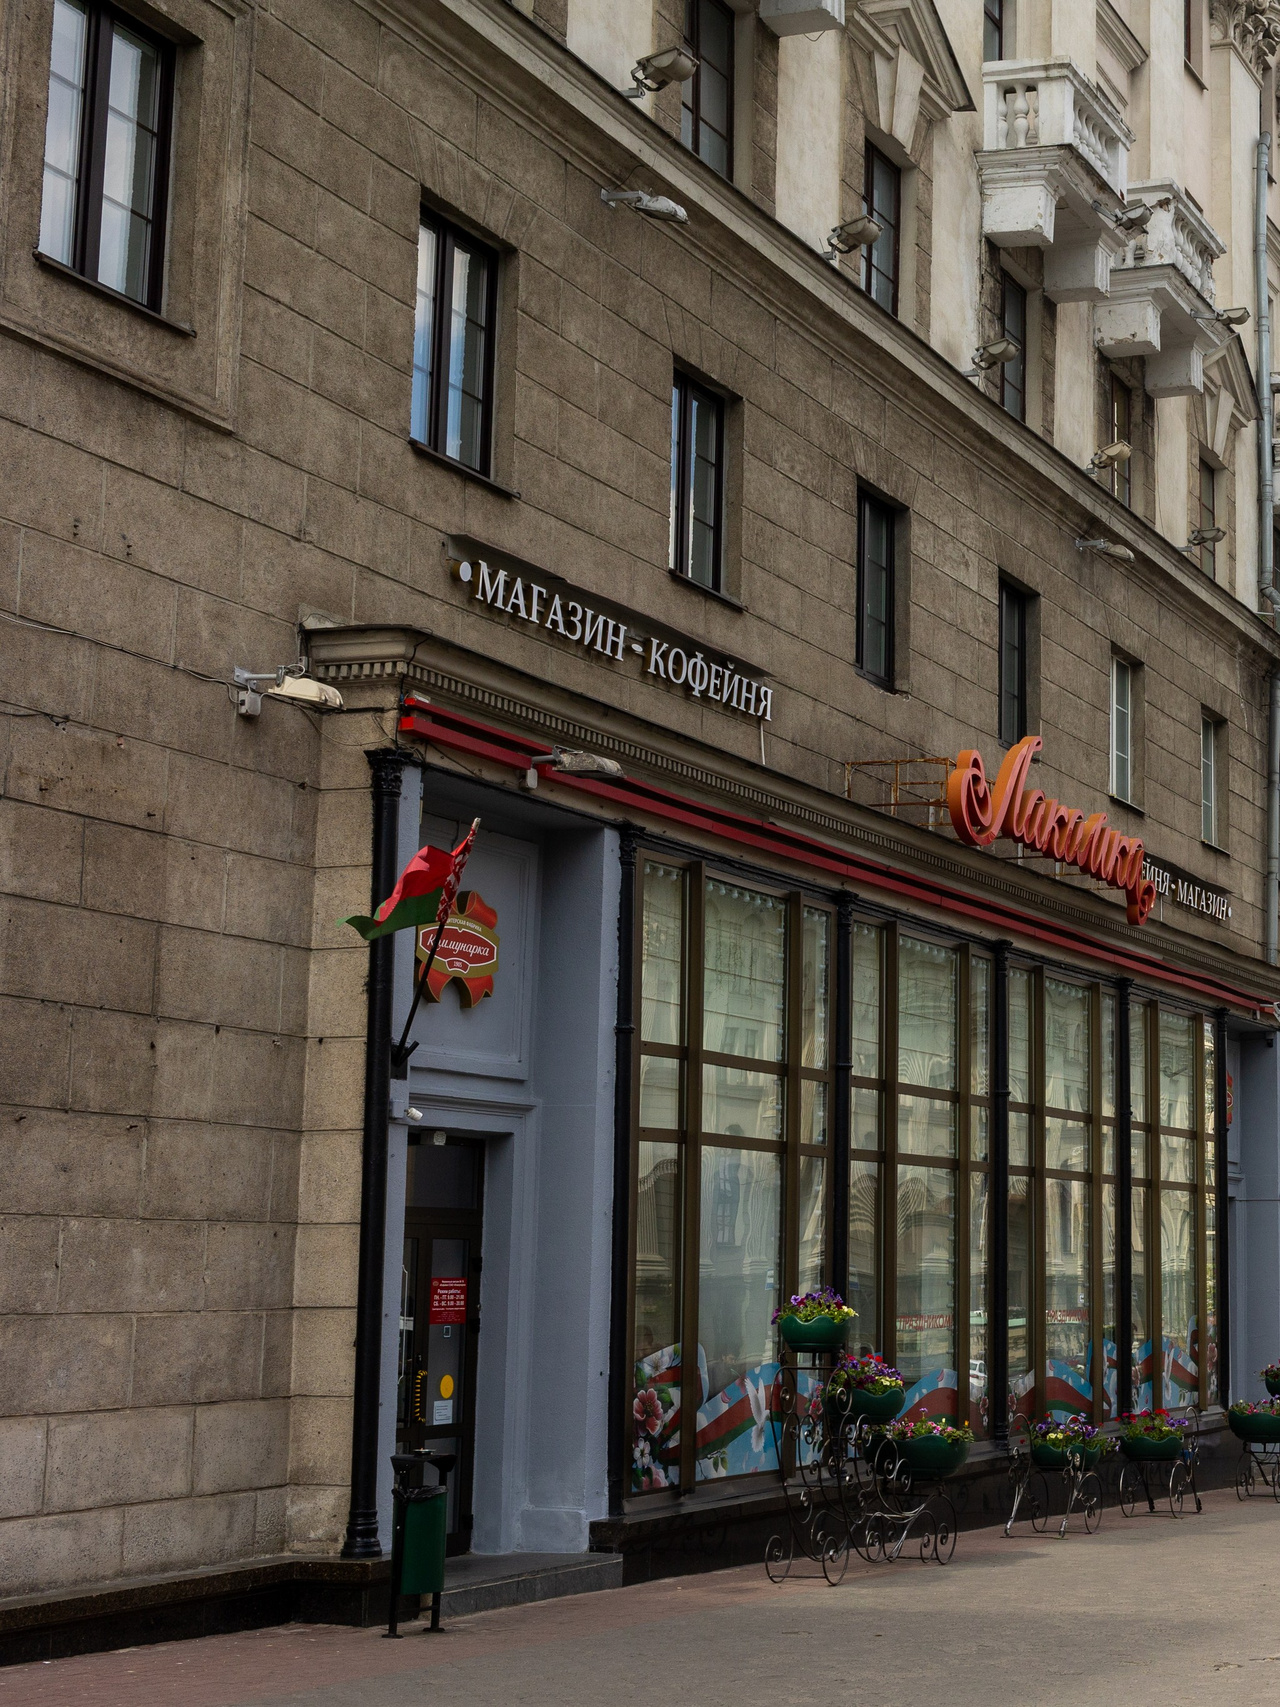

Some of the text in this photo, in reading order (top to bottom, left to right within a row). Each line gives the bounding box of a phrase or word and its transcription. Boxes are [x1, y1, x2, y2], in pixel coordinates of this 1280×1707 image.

[475, 559, 774, 722] МАГАЗИН КОФЕЙНЯ
[949, 735, 1157, 926] Лакомка
[426, 933, 490, 957] Кммунарка
[1176, 878, 1228, 921] МАГАЗИН
